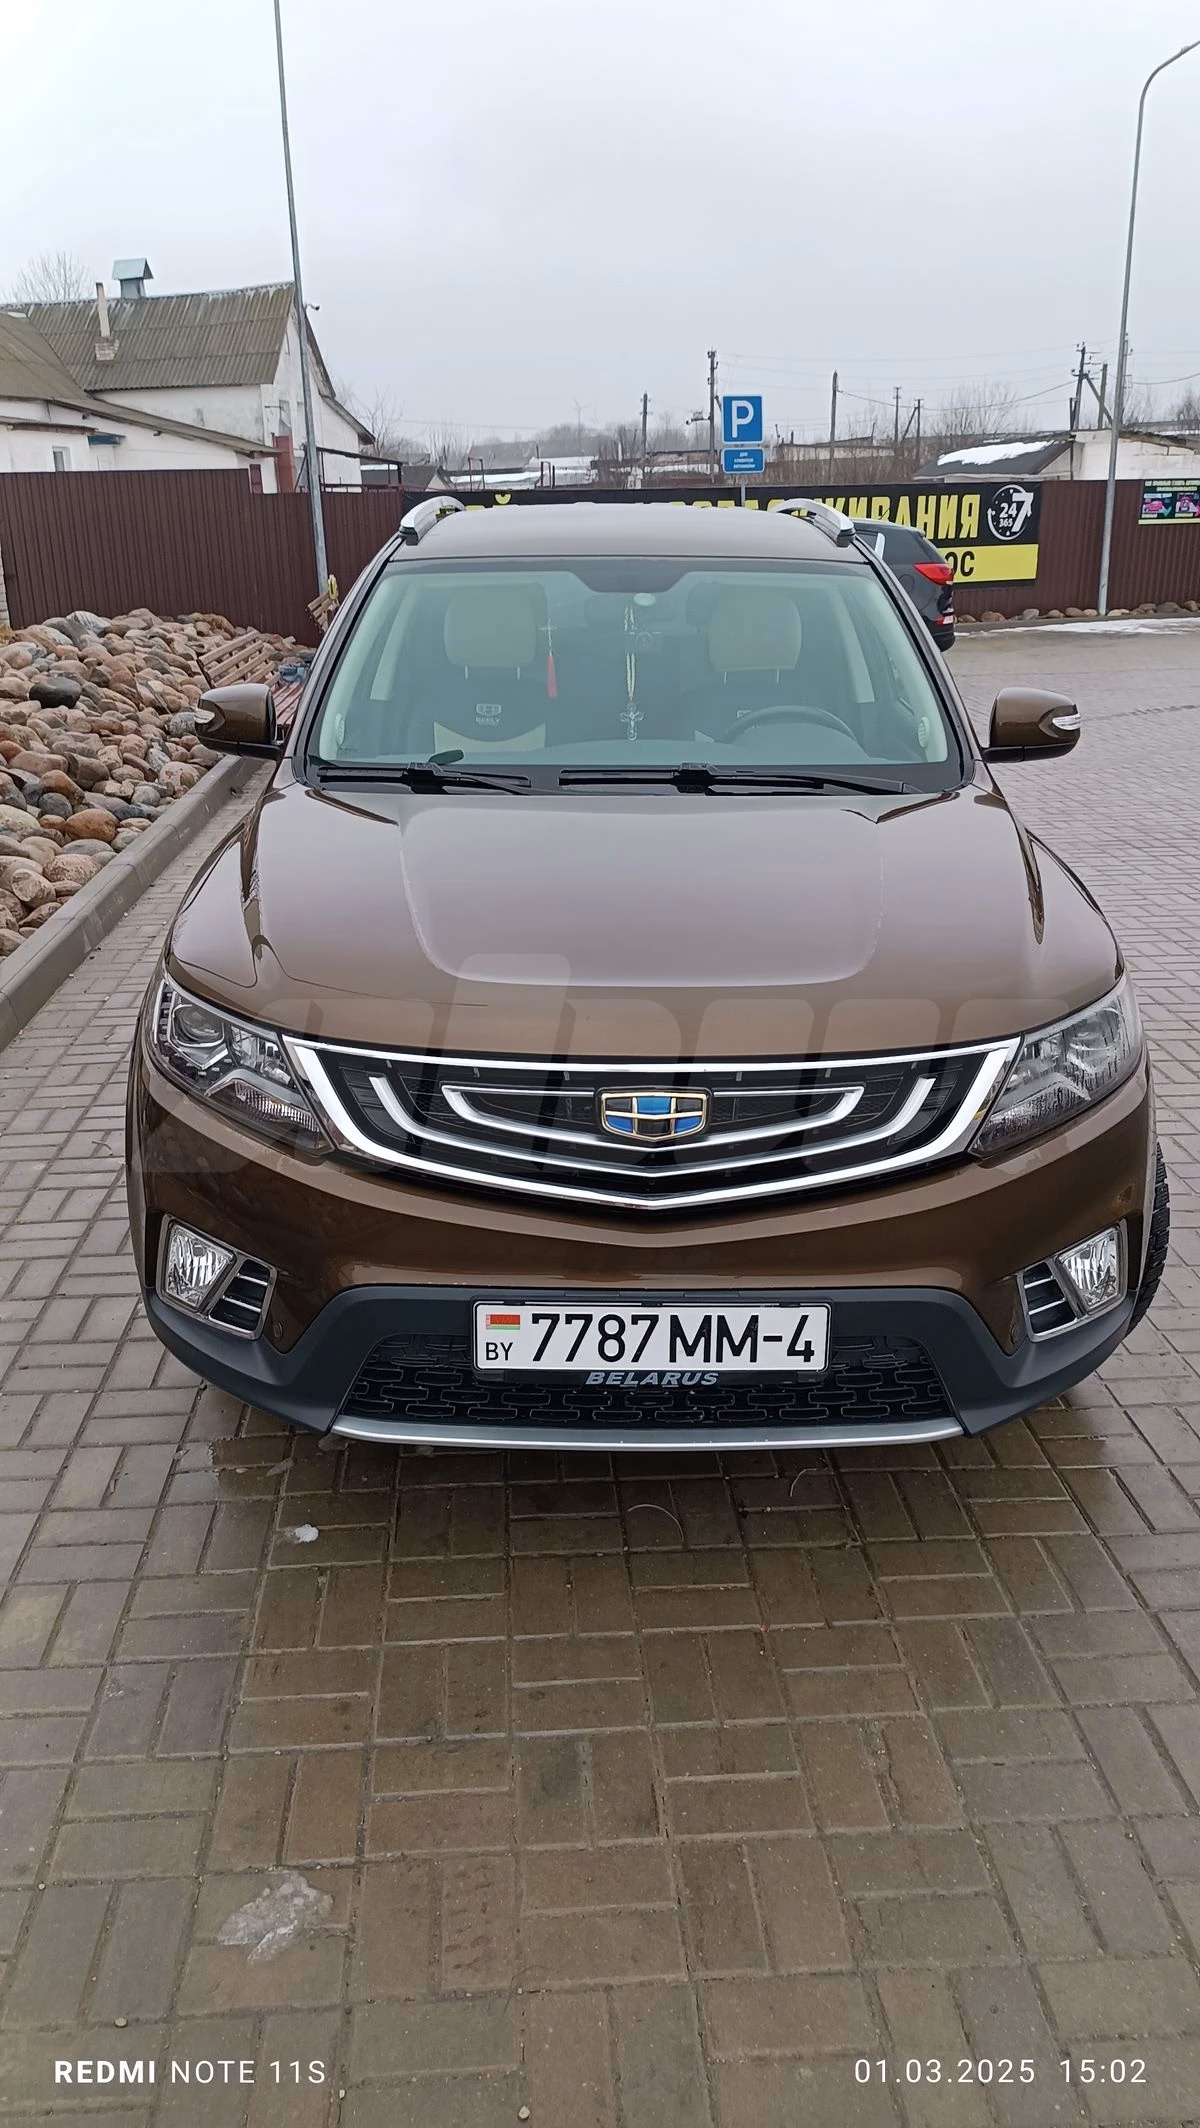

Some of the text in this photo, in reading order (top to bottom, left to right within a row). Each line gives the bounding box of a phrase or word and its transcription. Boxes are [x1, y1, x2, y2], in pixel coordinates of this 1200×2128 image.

[732, 400, 754, 438] P
[999, 502, 1017, 518] 24
[999, 518, 1013, 528] 365
[485, 1342, 513, 1361] BY
[585, 1371, 719, 1386] BELARUS
